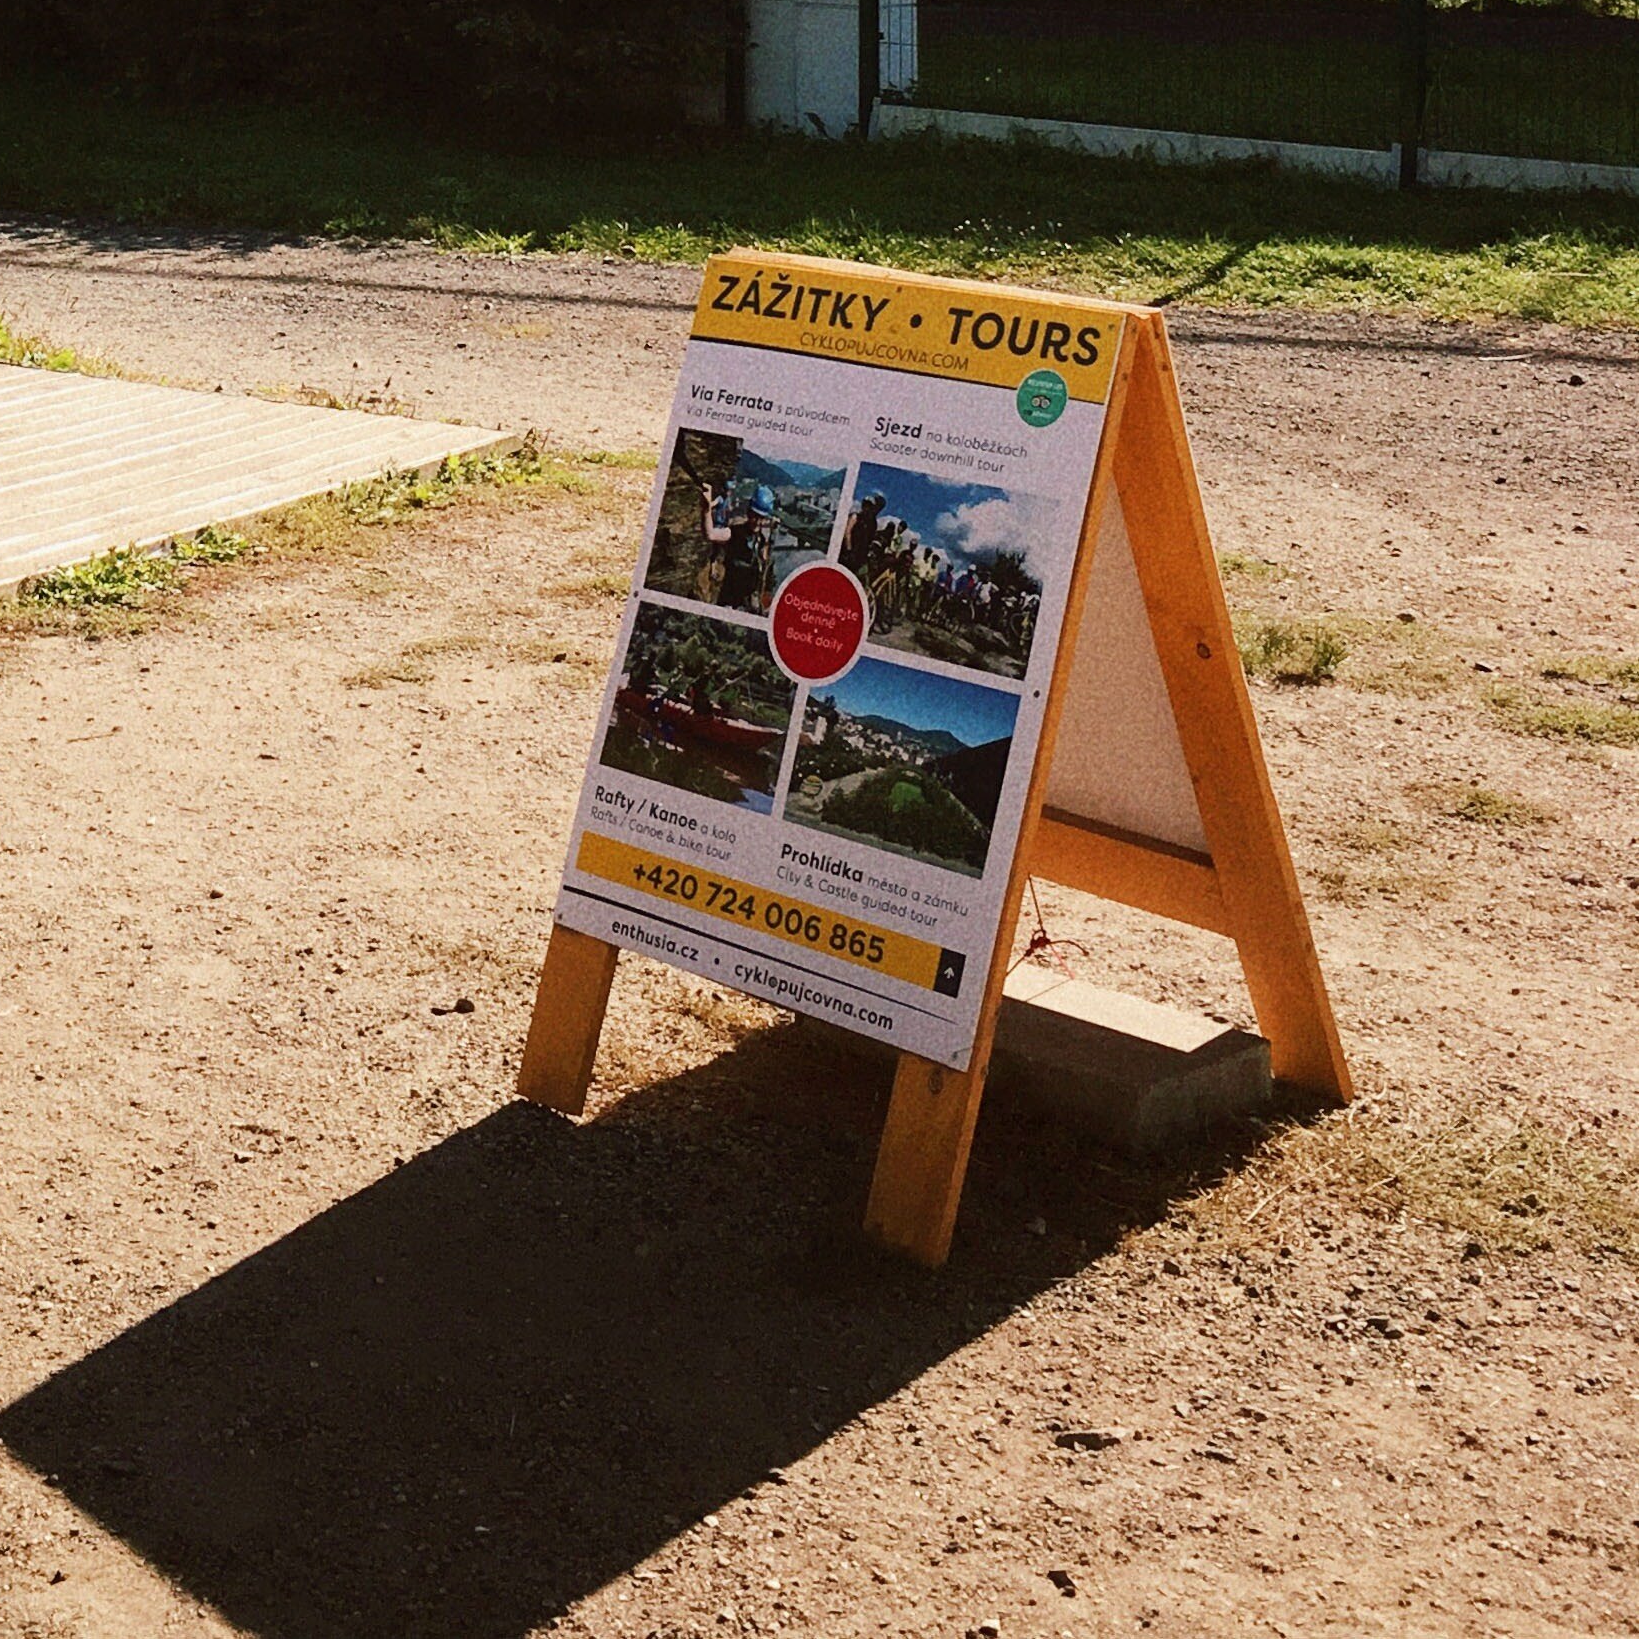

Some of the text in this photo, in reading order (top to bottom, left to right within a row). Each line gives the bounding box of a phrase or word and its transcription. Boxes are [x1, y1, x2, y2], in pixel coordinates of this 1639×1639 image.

[711, 270, 1101, 367] ZÁŽITKY TOURS
[686, 404, 814, 437] Via Ferrata guided tour
[691, 384, 714, 401] Via
[717, 389, 773, 412] Ferrata
[785, 405, 851, 426] průvodcem
[869, 437, 1005, 473] Scooter downhill tour
[874, 416, 1028, 458] Sjezd na koloběžkách
[784, 593, 859, 621] Objednávejte
[800, 611, 836, 629] denně
[786, 627, 843, 654] Book daily
[590, 806, 618, 826] Rafts
[628, 818, 664, 840] Canoe
[666, 832, 676, 844] &
[678, 834, 703, 853] bike
[706, 845, 732, 861] tour
[595, 785, 737, 845] Rafty / Kanoe a kolo
[776, 865, 939, 928] City & Castle guided tour
[780, 843, 969, 917] Prohlídka města a zámku
[633, 863, 886, 964] +420 724 006 865
[611, 919, 894, 1031] enthusia.cz cyklopujcovna.com
